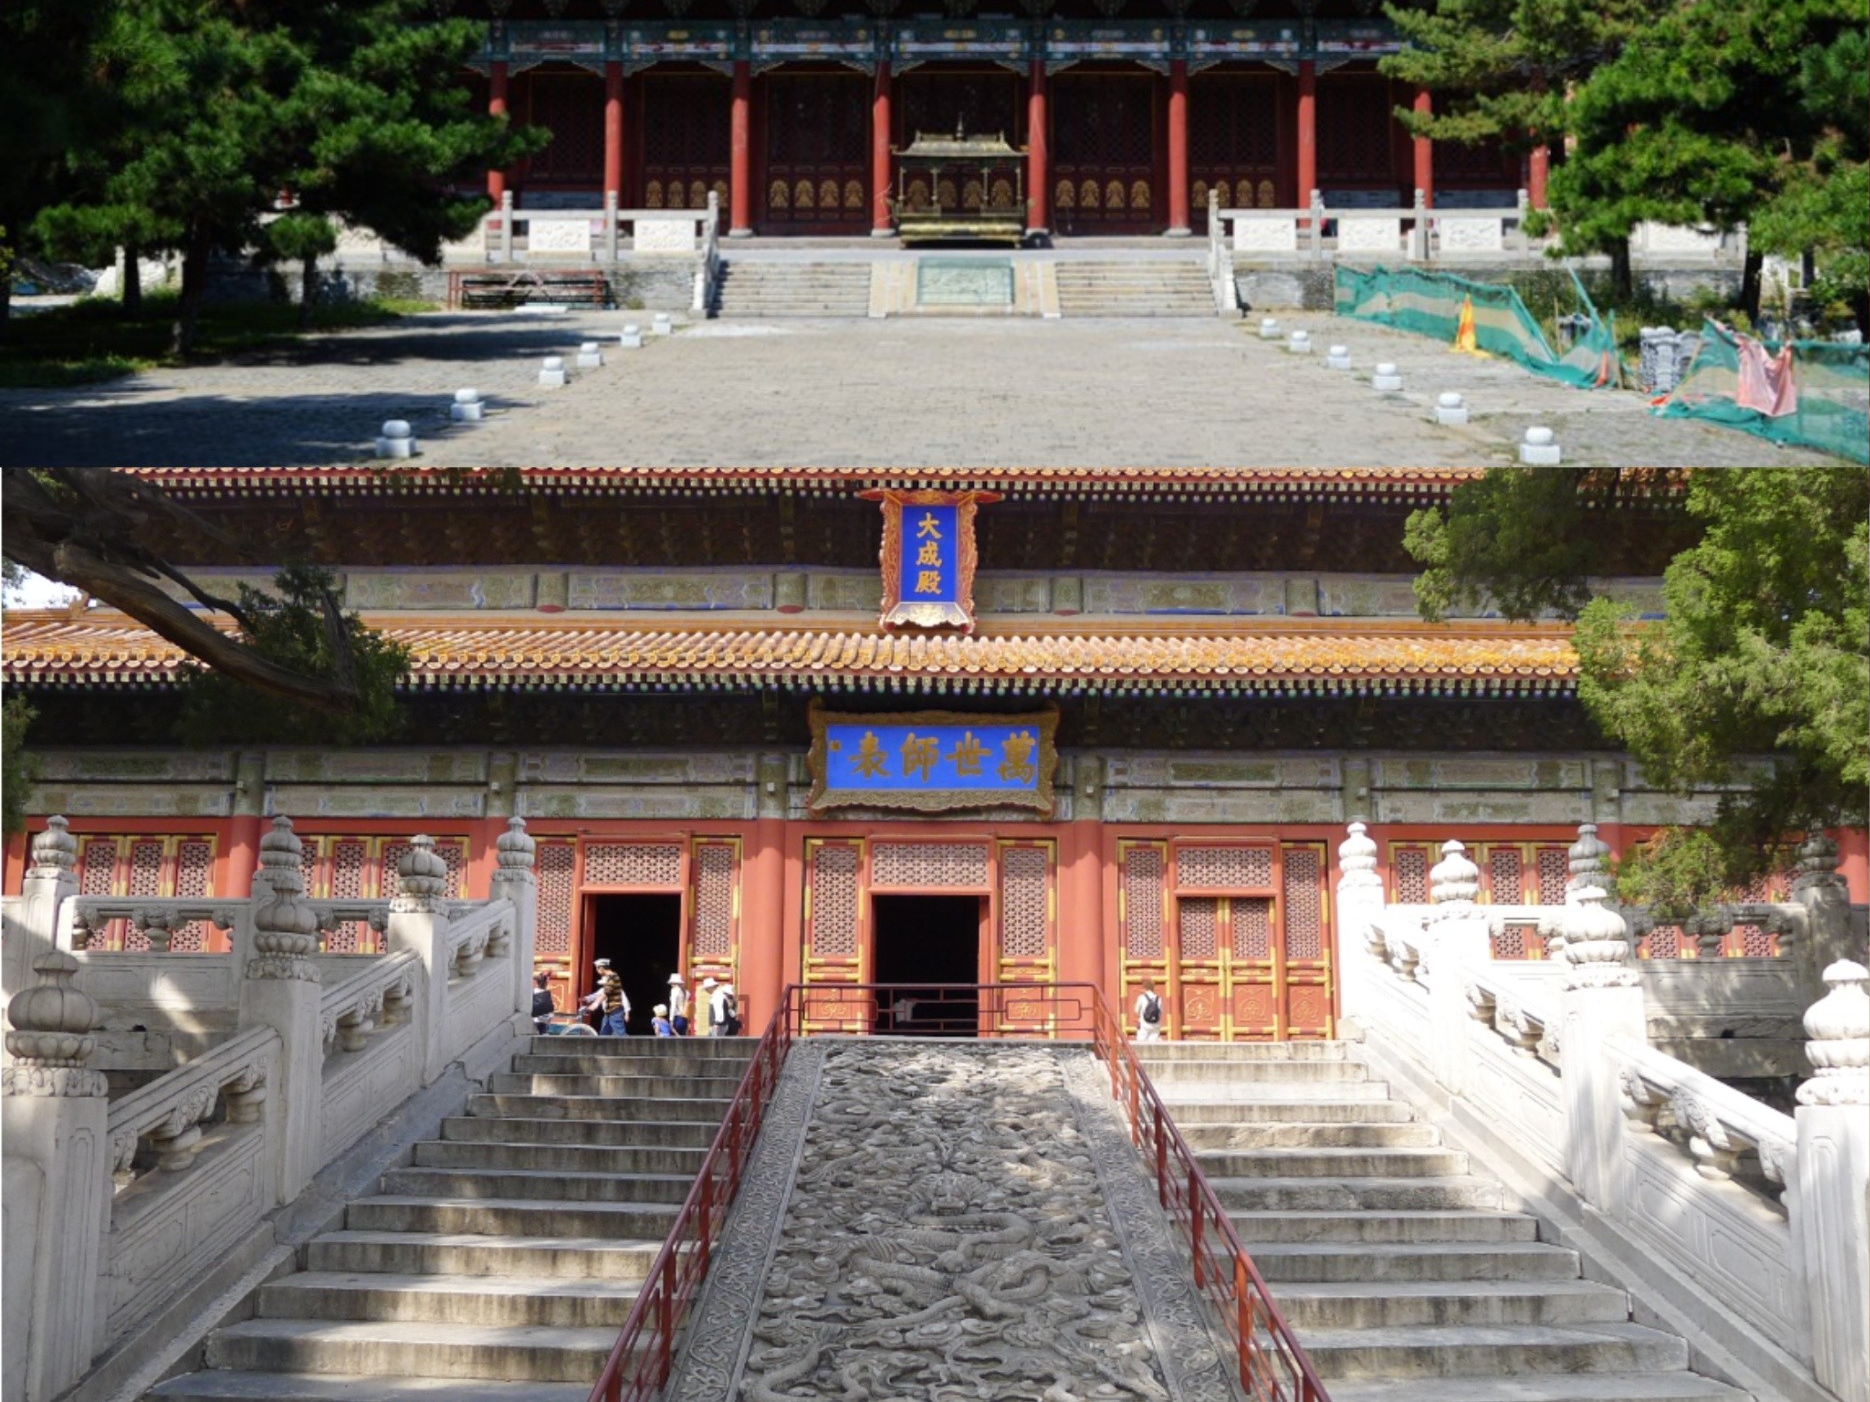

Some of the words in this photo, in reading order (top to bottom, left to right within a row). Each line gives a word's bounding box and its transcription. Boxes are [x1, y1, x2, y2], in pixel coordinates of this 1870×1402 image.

[914, 511, 942, 594] 大成殿
[848, 730, 1036, 785] 萬世師表
